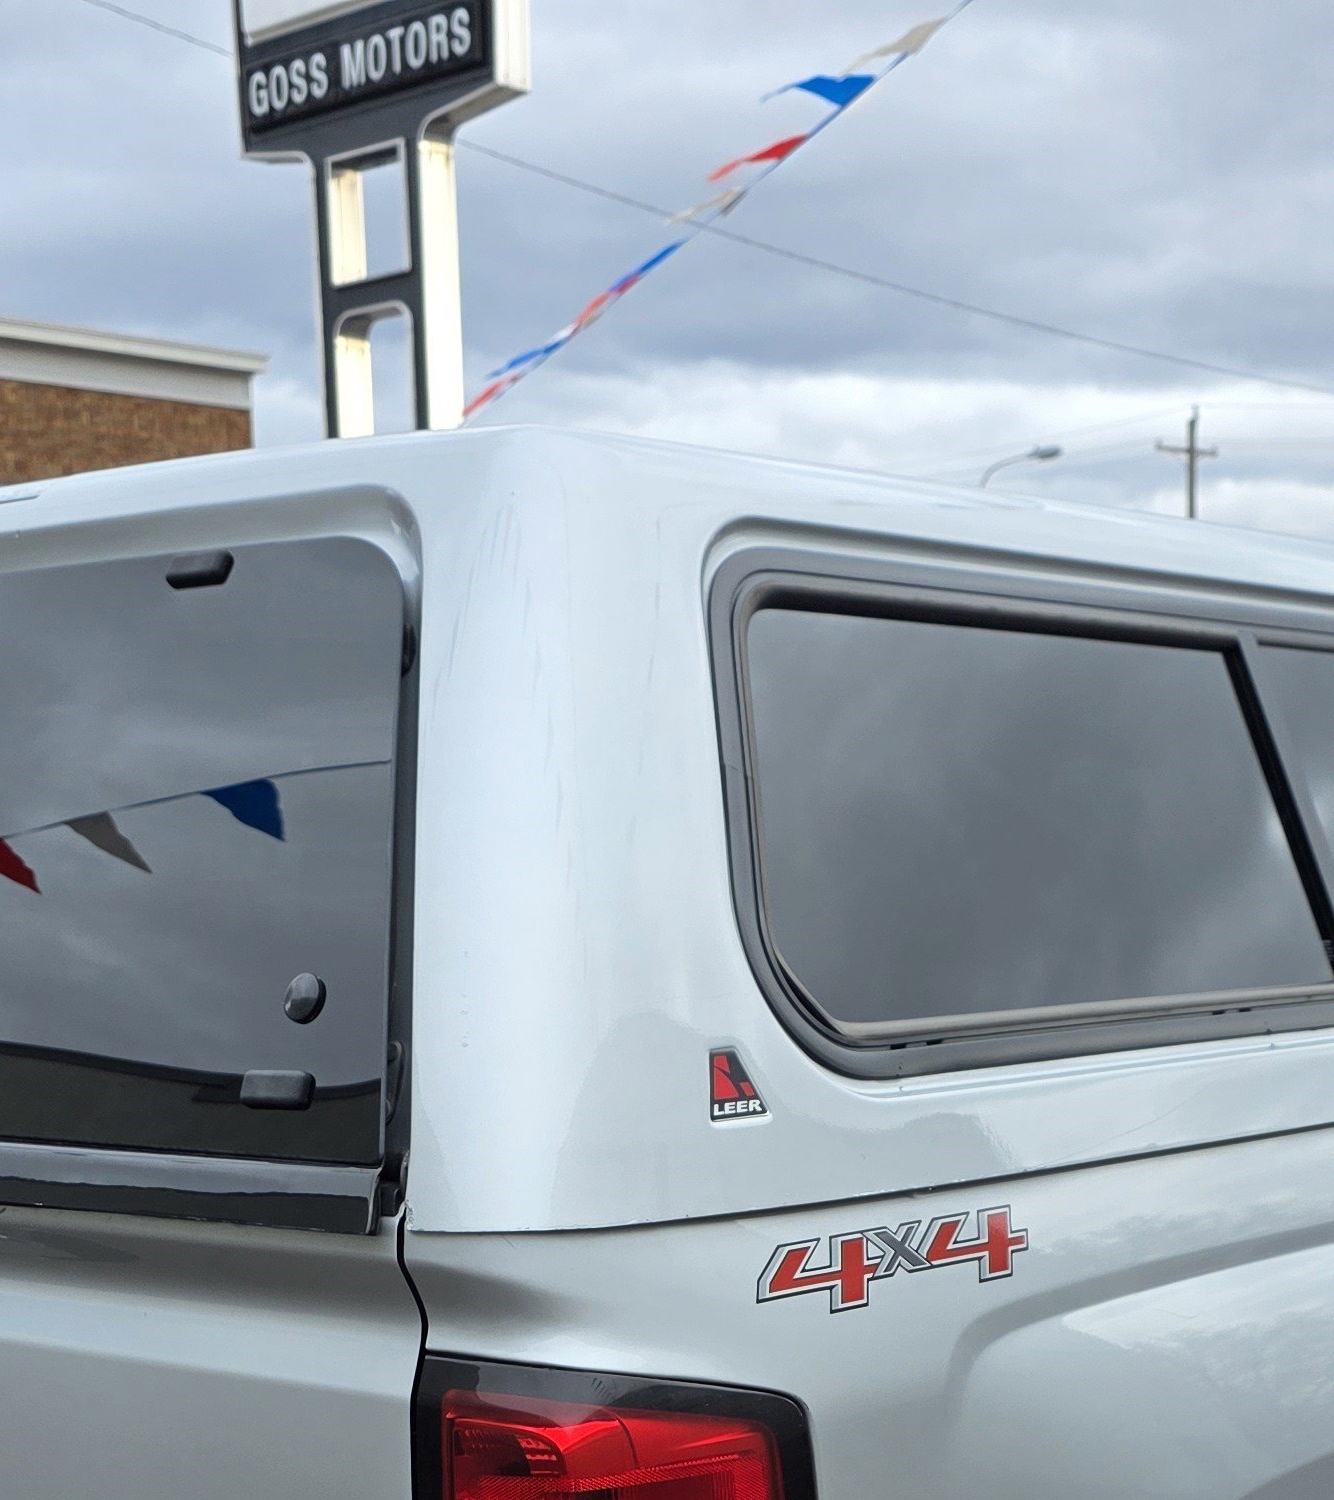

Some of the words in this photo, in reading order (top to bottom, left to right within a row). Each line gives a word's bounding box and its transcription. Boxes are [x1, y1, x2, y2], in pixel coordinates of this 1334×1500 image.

[248, 52, 329, 118] GOSS
[340, 8, 471, 90] MOTORS
[713, 1099, 763, 1117] LEER
